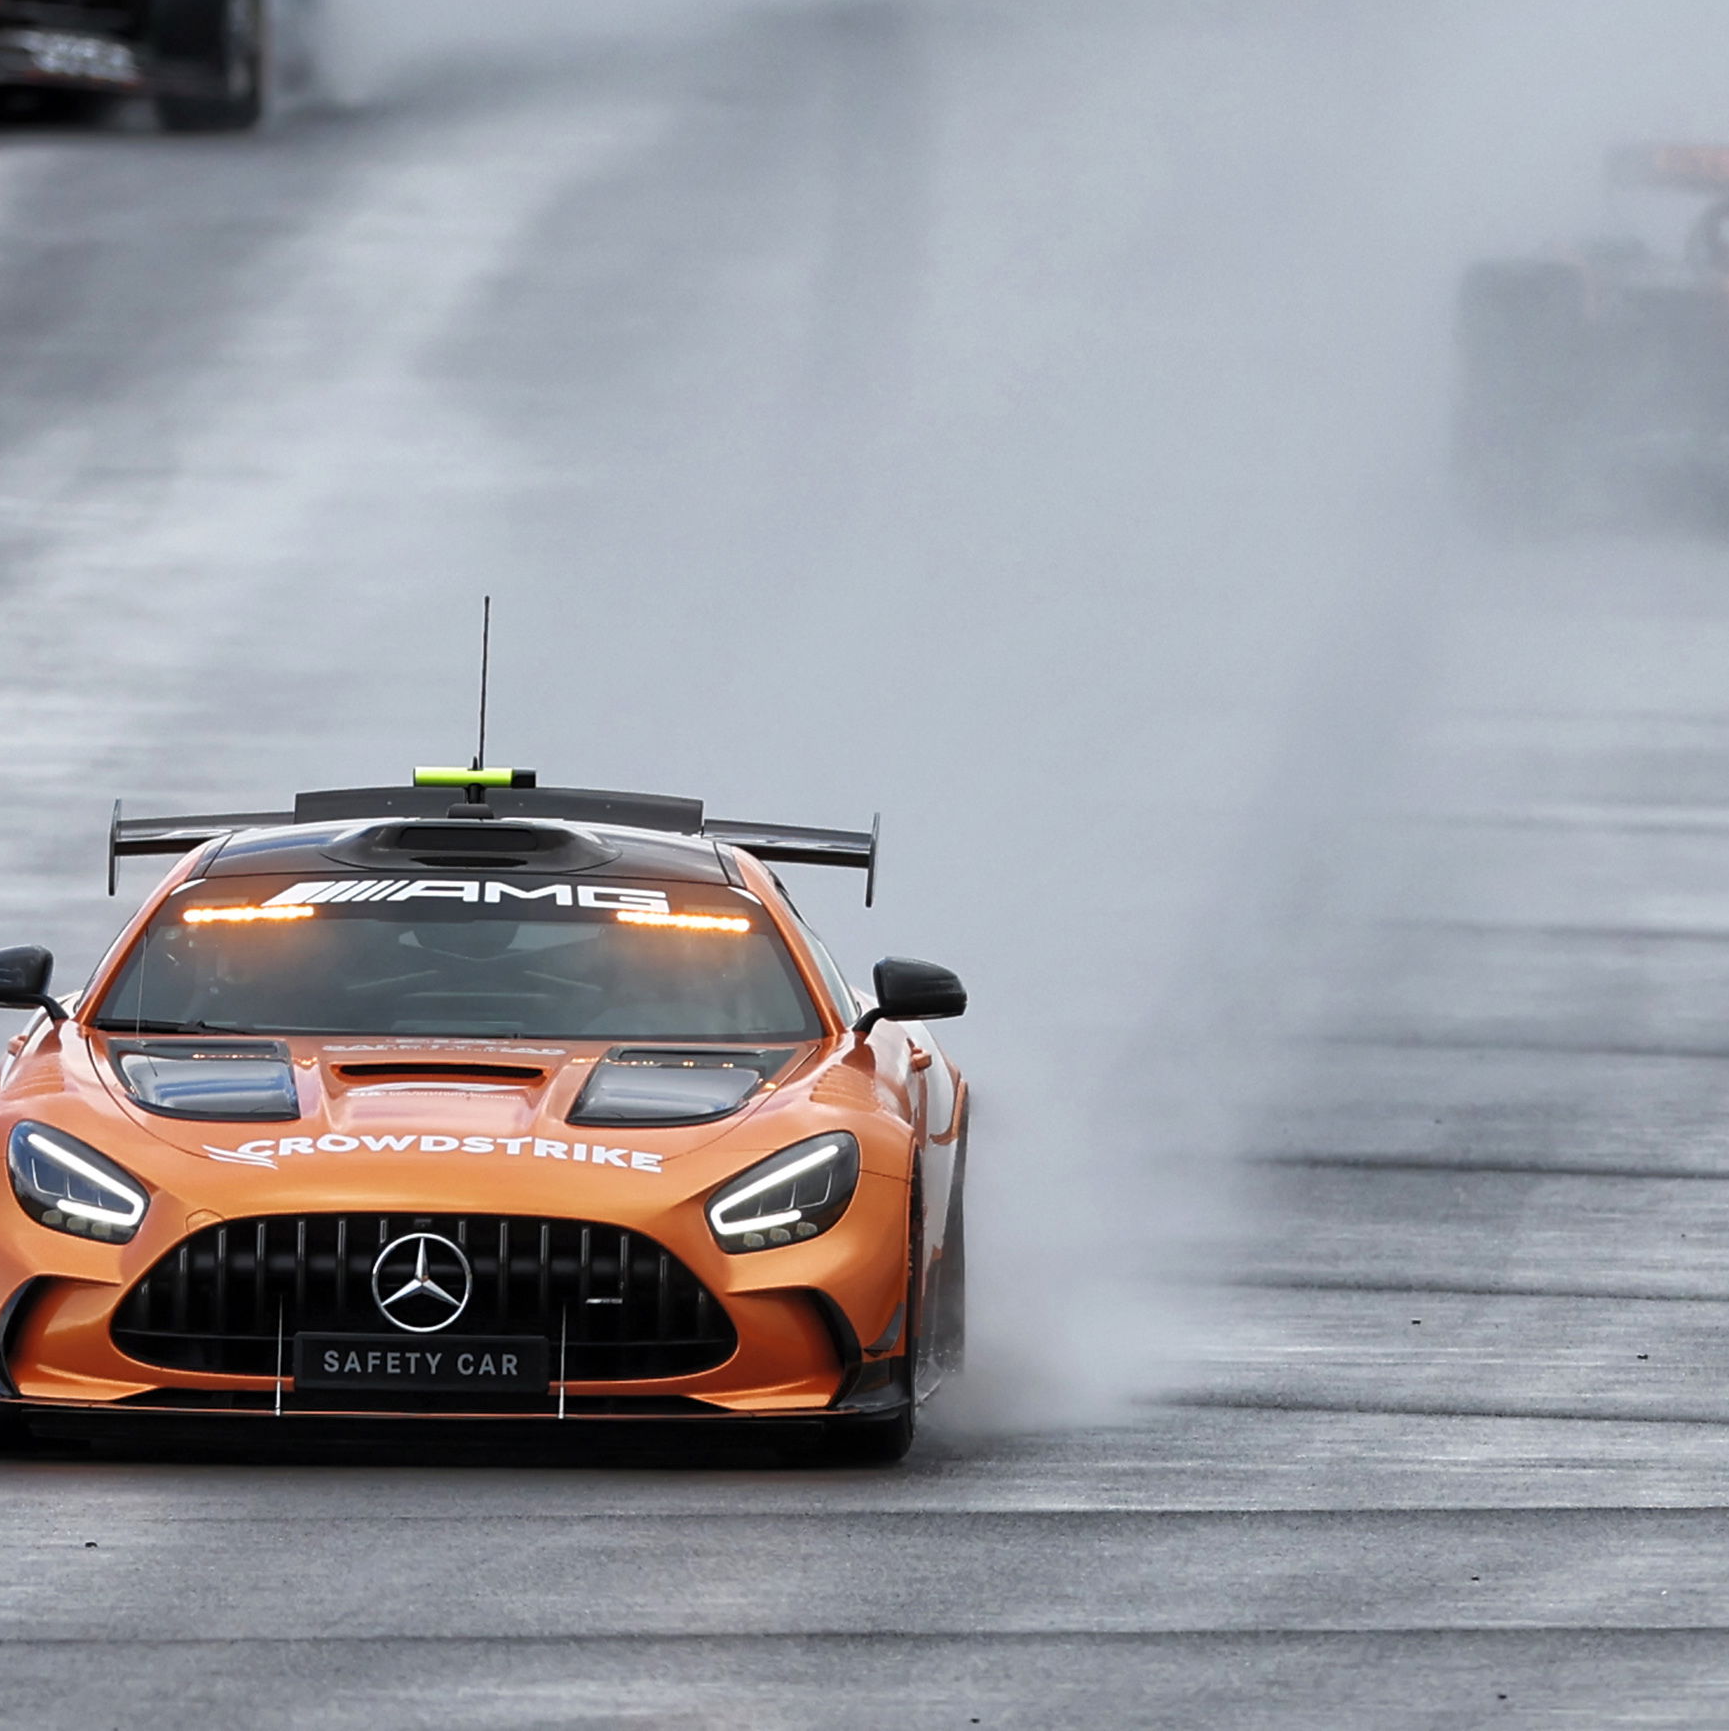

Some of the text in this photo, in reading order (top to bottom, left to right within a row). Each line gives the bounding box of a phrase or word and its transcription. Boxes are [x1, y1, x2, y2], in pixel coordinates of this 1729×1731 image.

[386, 880, 670, 912] AMG
[237, 1133, 663, 1173] CROWDSTRIKE
[323, 1349, 519, 1376] SAFETY CAR
